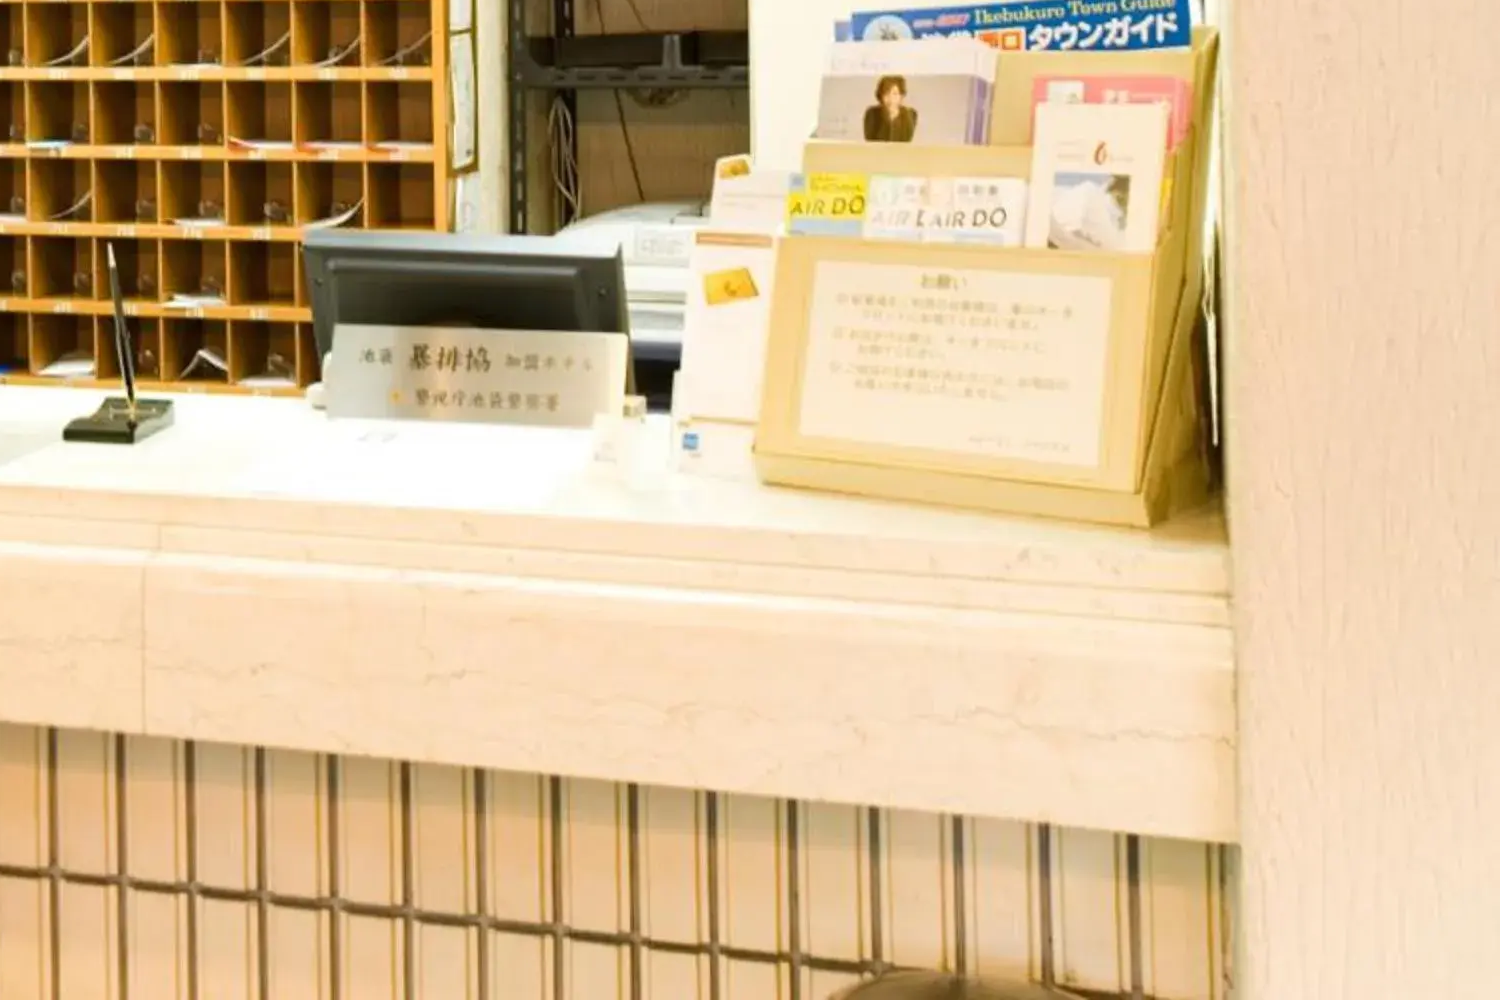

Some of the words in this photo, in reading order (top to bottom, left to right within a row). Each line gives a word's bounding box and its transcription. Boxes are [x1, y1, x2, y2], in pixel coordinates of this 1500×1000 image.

[973, 4, 1066, 26] Ikebukuro
[1067, 0, 1118, 17] Town
[1028, 12, 1179, 51] タウンガイド
[789, 199, 826, 216] AIR
[831, 194, 866, 216] DO
[930, 211, 965, 228] AIR
[971, 206, 1008, 228] DO
